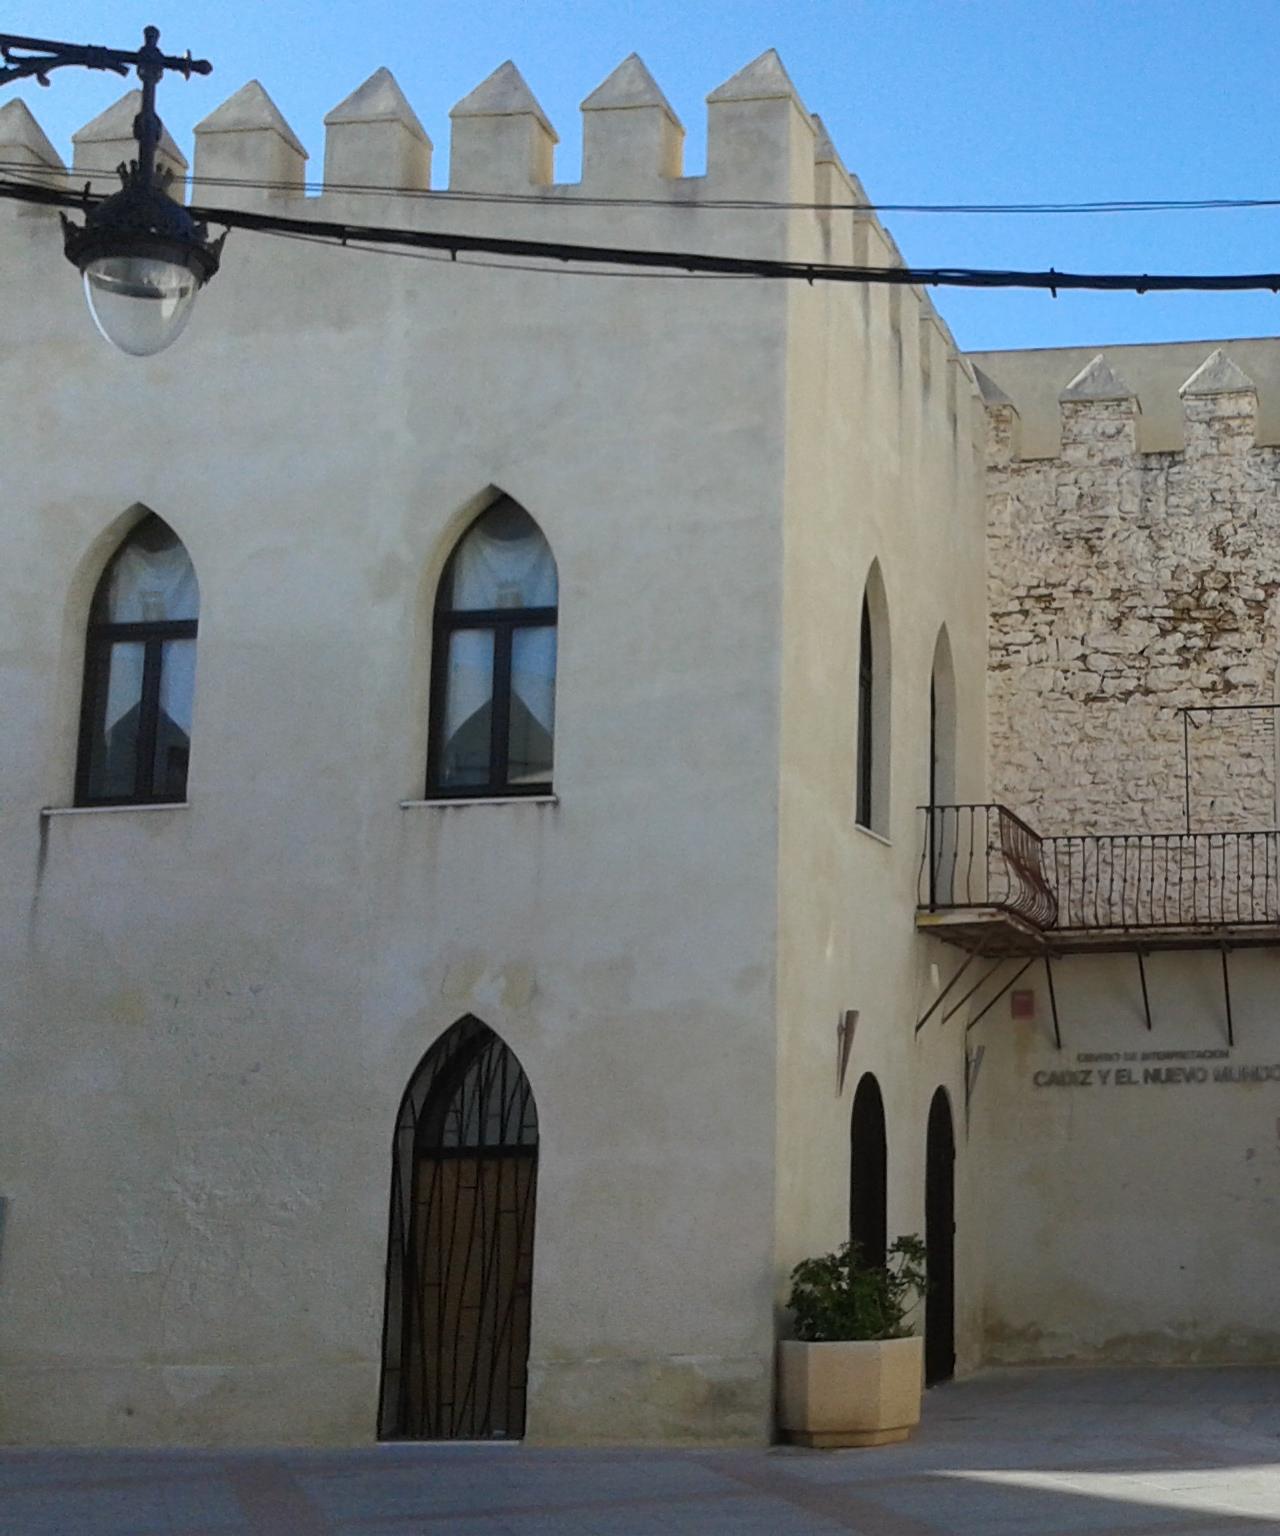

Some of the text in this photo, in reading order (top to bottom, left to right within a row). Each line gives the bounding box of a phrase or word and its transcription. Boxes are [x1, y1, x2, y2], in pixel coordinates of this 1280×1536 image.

[1097, 1068, 1111, 1085] Y
[1115, 1067, 1140, 1086] EL
[1142, 1066, 1208, 1085] NUEVO
